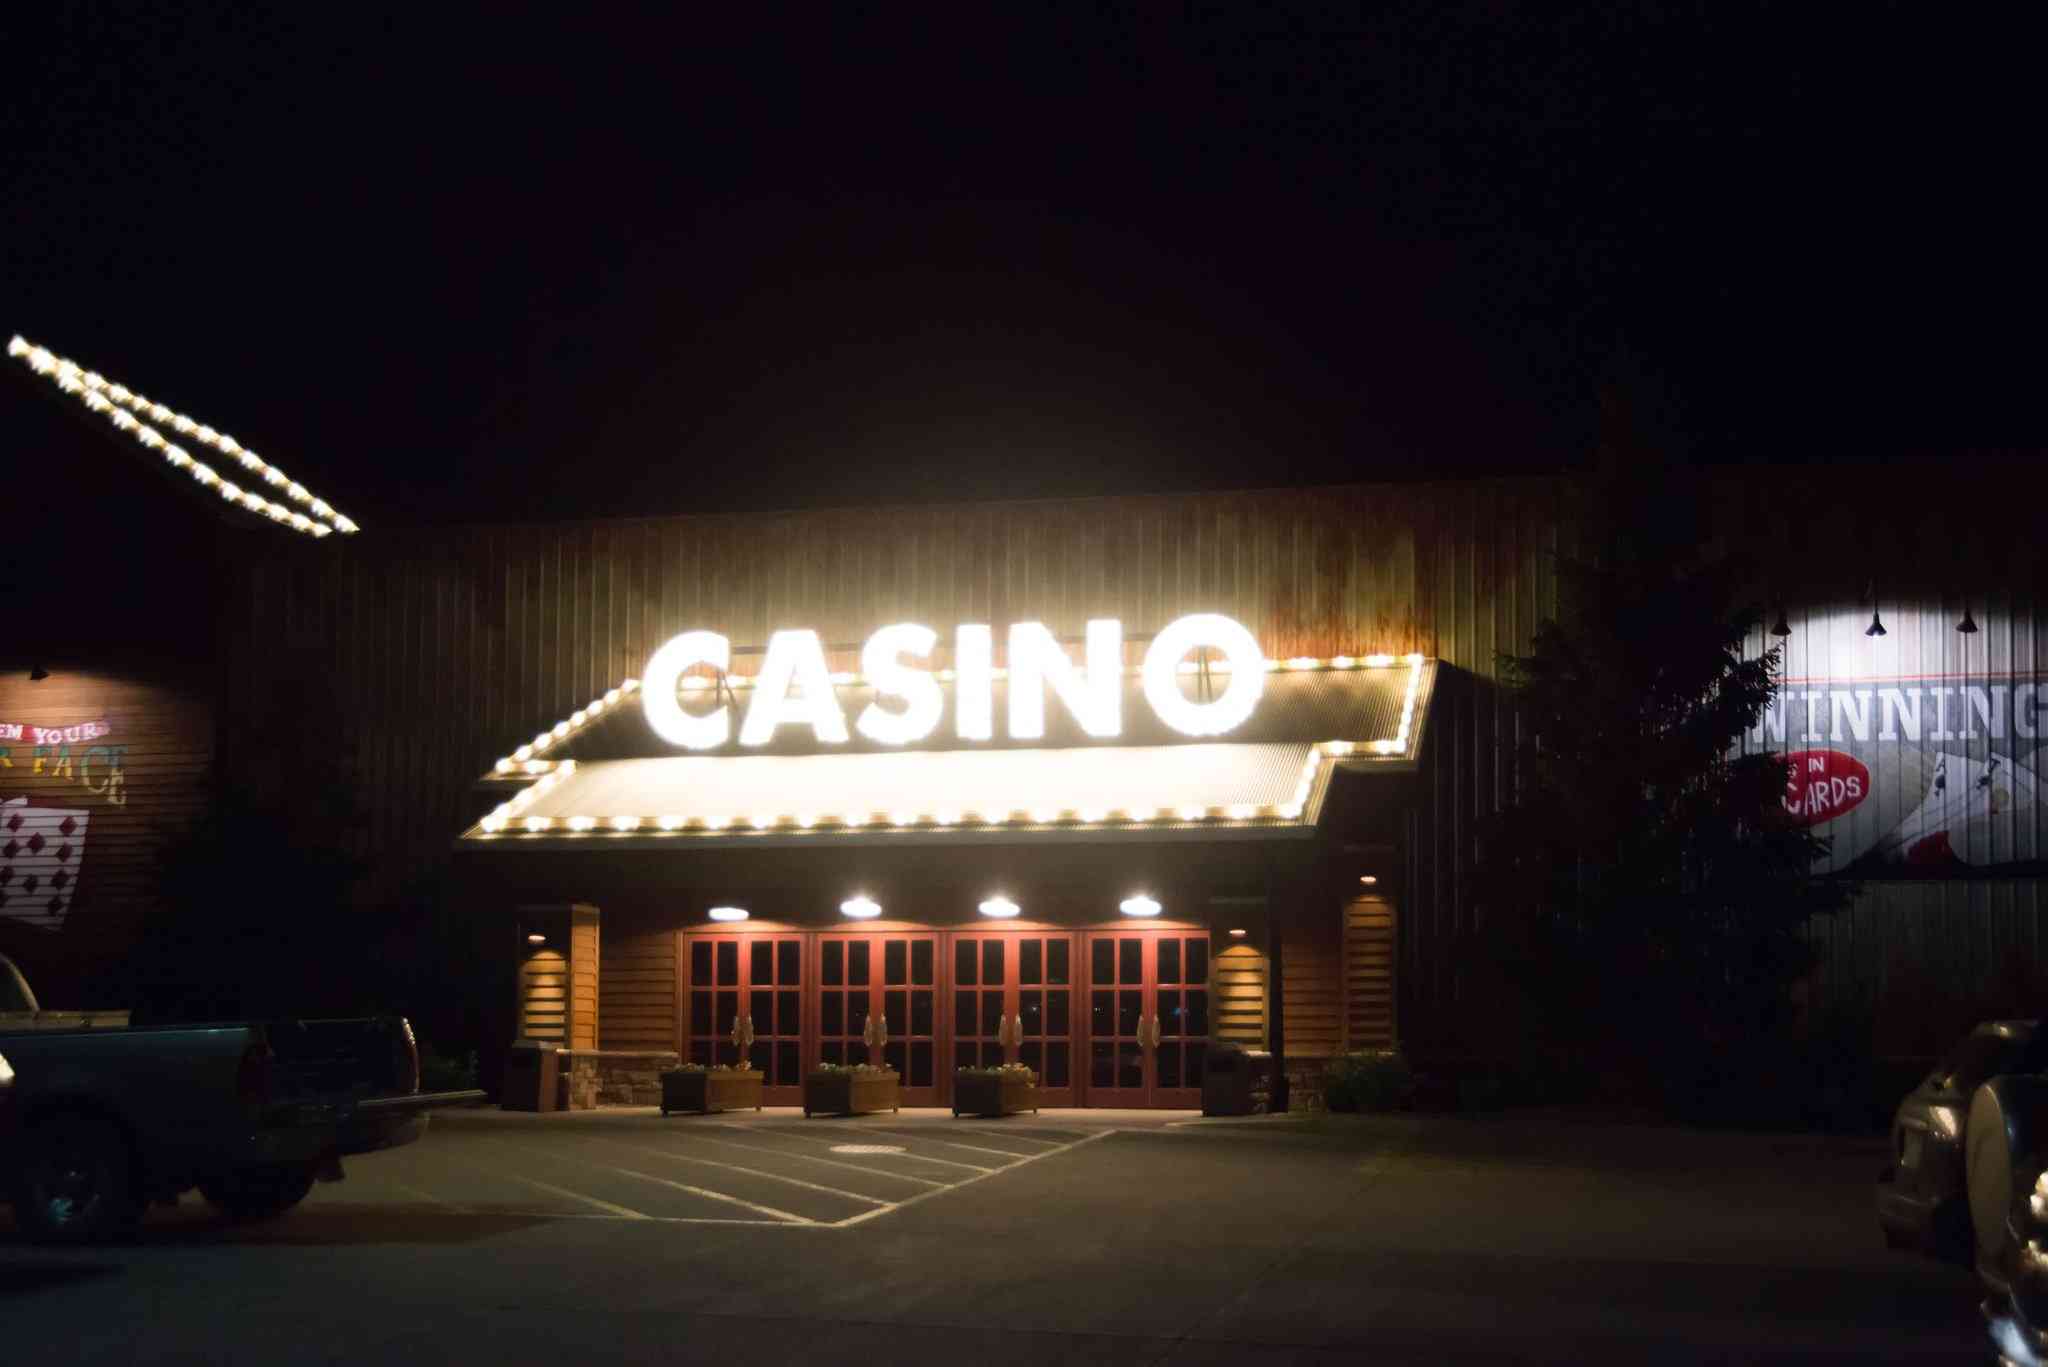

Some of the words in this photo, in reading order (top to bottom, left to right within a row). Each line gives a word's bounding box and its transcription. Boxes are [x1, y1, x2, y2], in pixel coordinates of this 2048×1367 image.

[640, 613, 1265, 750] CASINO
[33, 722, 97, 744] YOUR
[33, 746, 129, 806] FACE
[1808, 757, 1825, 773] IN
